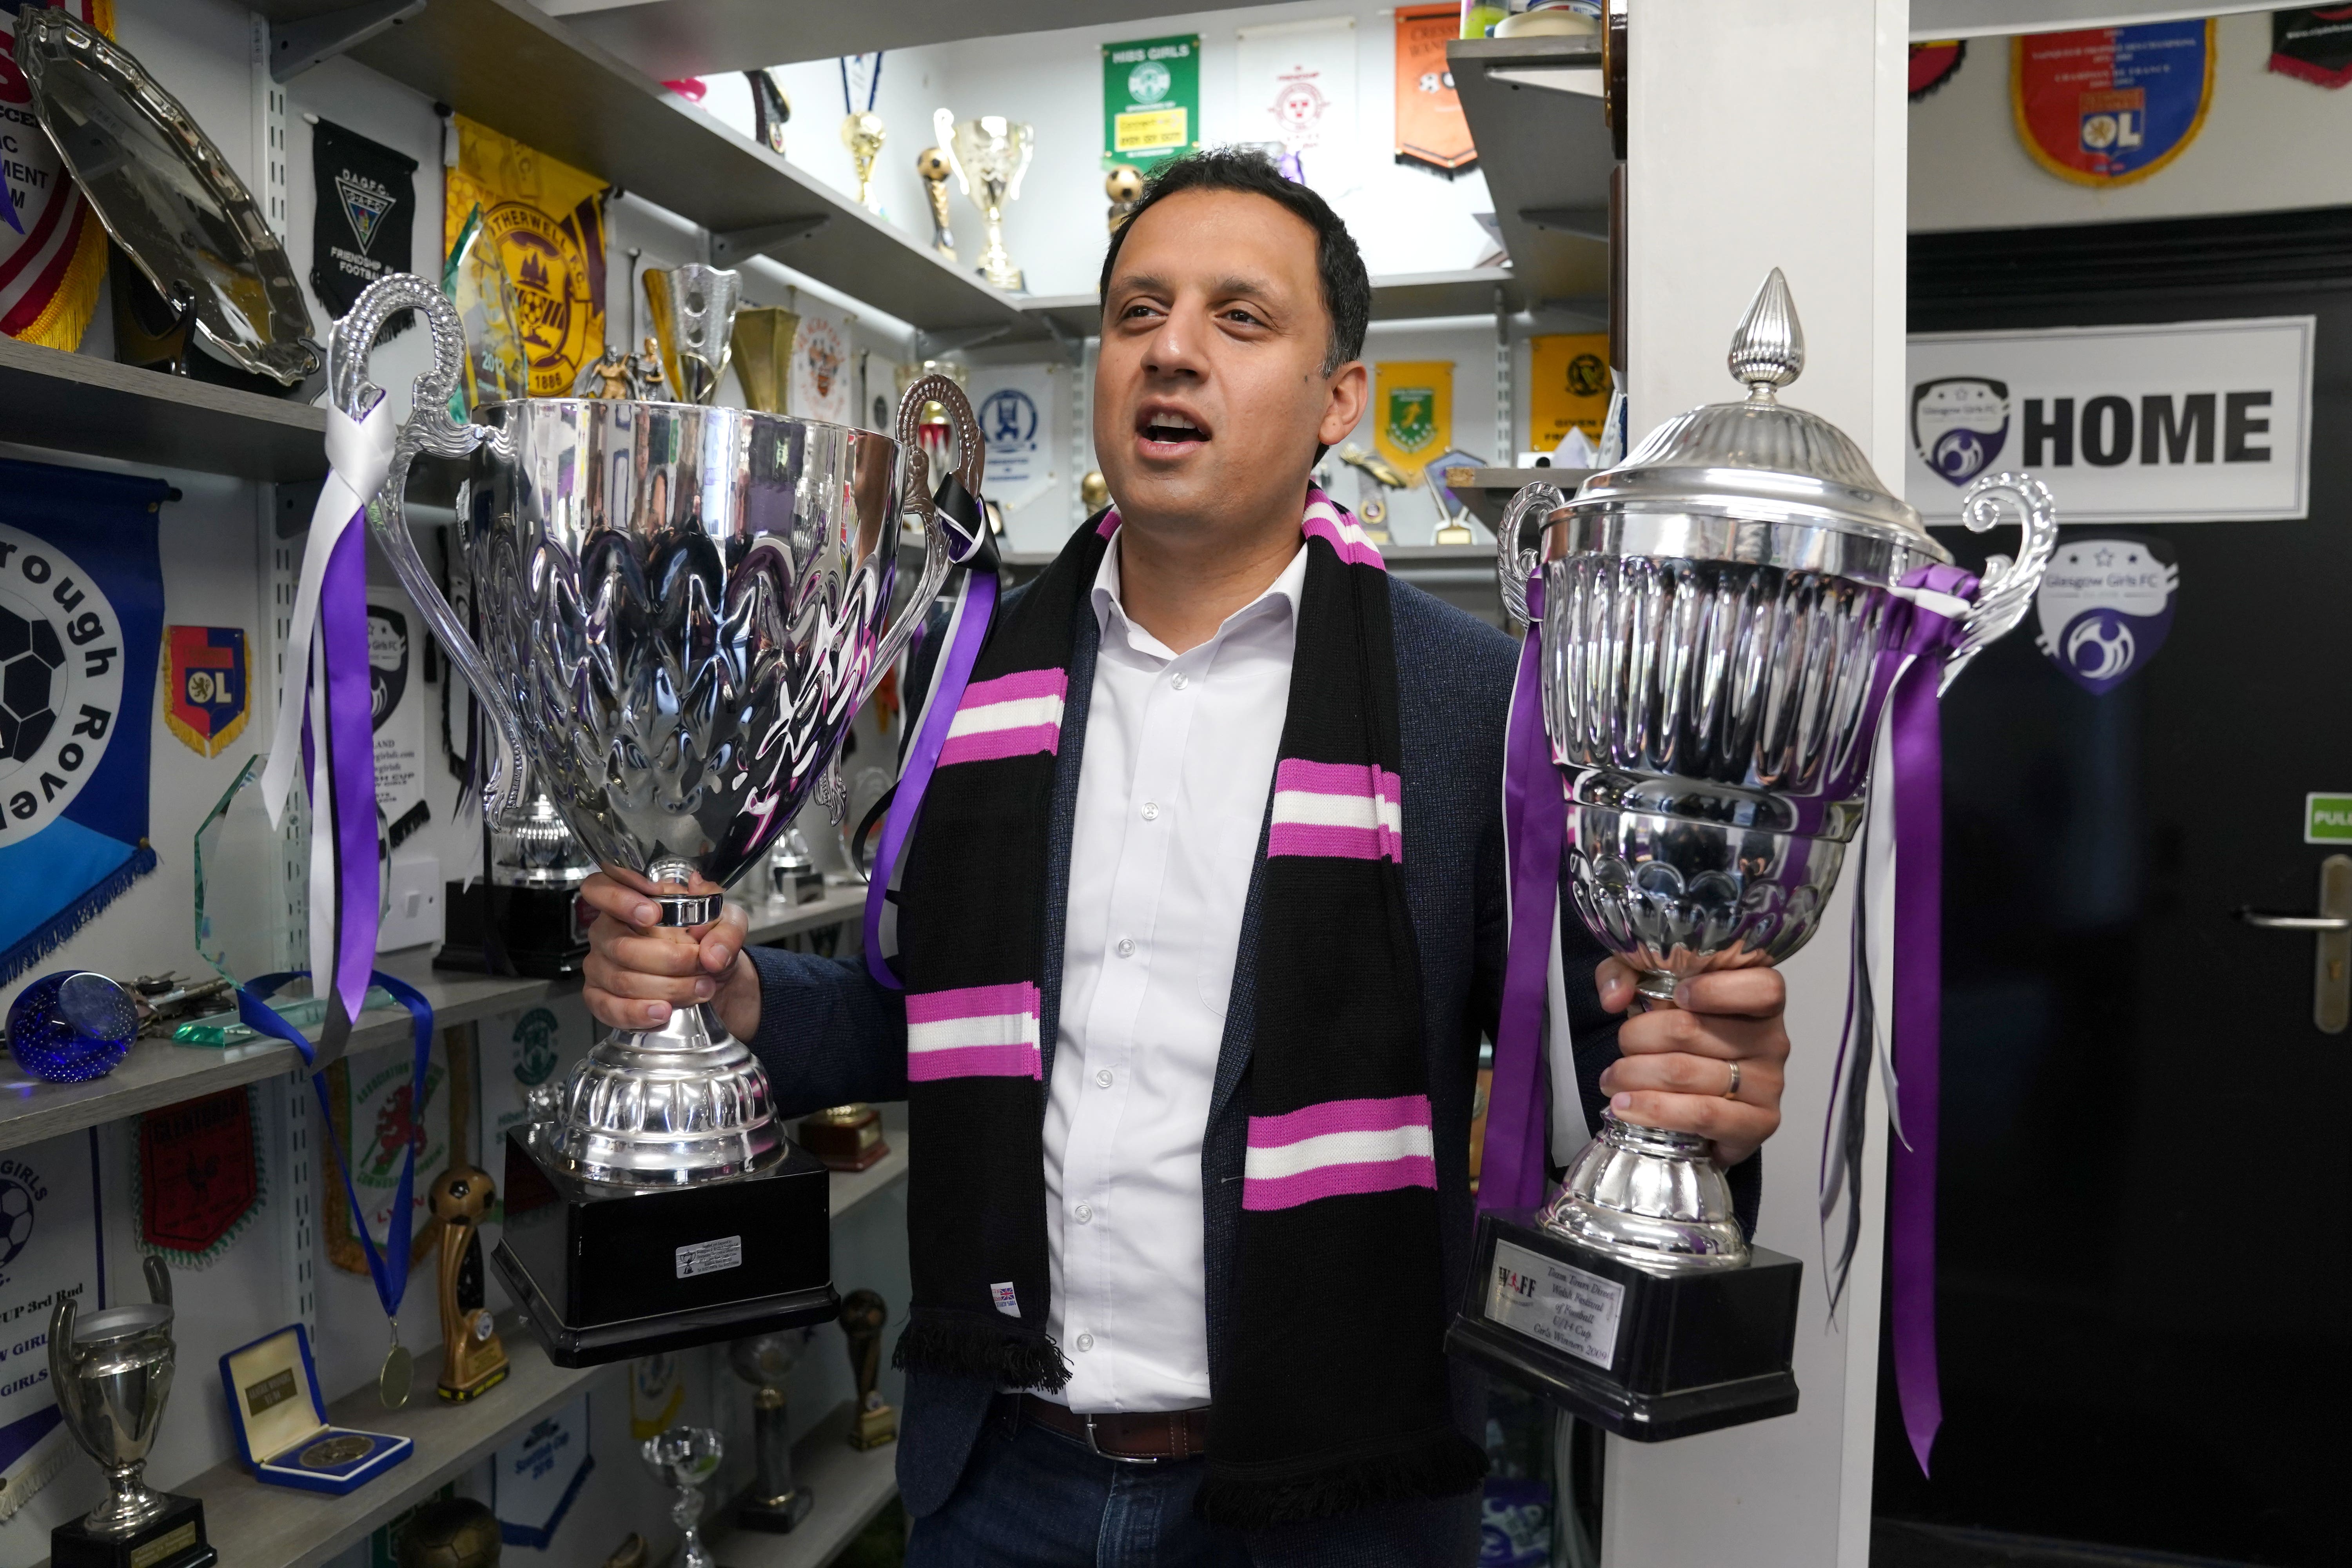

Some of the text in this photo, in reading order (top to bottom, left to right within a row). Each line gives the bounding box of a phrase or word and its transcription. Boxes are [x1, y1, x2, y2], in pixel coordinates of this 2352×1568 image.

[2023, 390, 2272, 467] HOME
[2045, 571, 2158, 590] Glasgow Girls FC
[188, 671, 232, 703] OL
[0, 1159, 48, 1202] GIRLS
[1548, 1266, 1614, 1299] Team Tours Direct
[0, 1305, 24, 1325] UP
[28, 1295, 52, 1314] 3rd
[1552, 1283, 1573, 1300] Welsh
[1575, 1292, 1604, 1312] Festival
[1555, 1302, 1595, 1324] of Football
[1554, 1331, 1584, 1352] Winners
[1586, 1345, 1608, 1360] 2009
[1575, 1325, 1592, 1342] Cup
[0, 1368, 48, 1396] GIRLS
